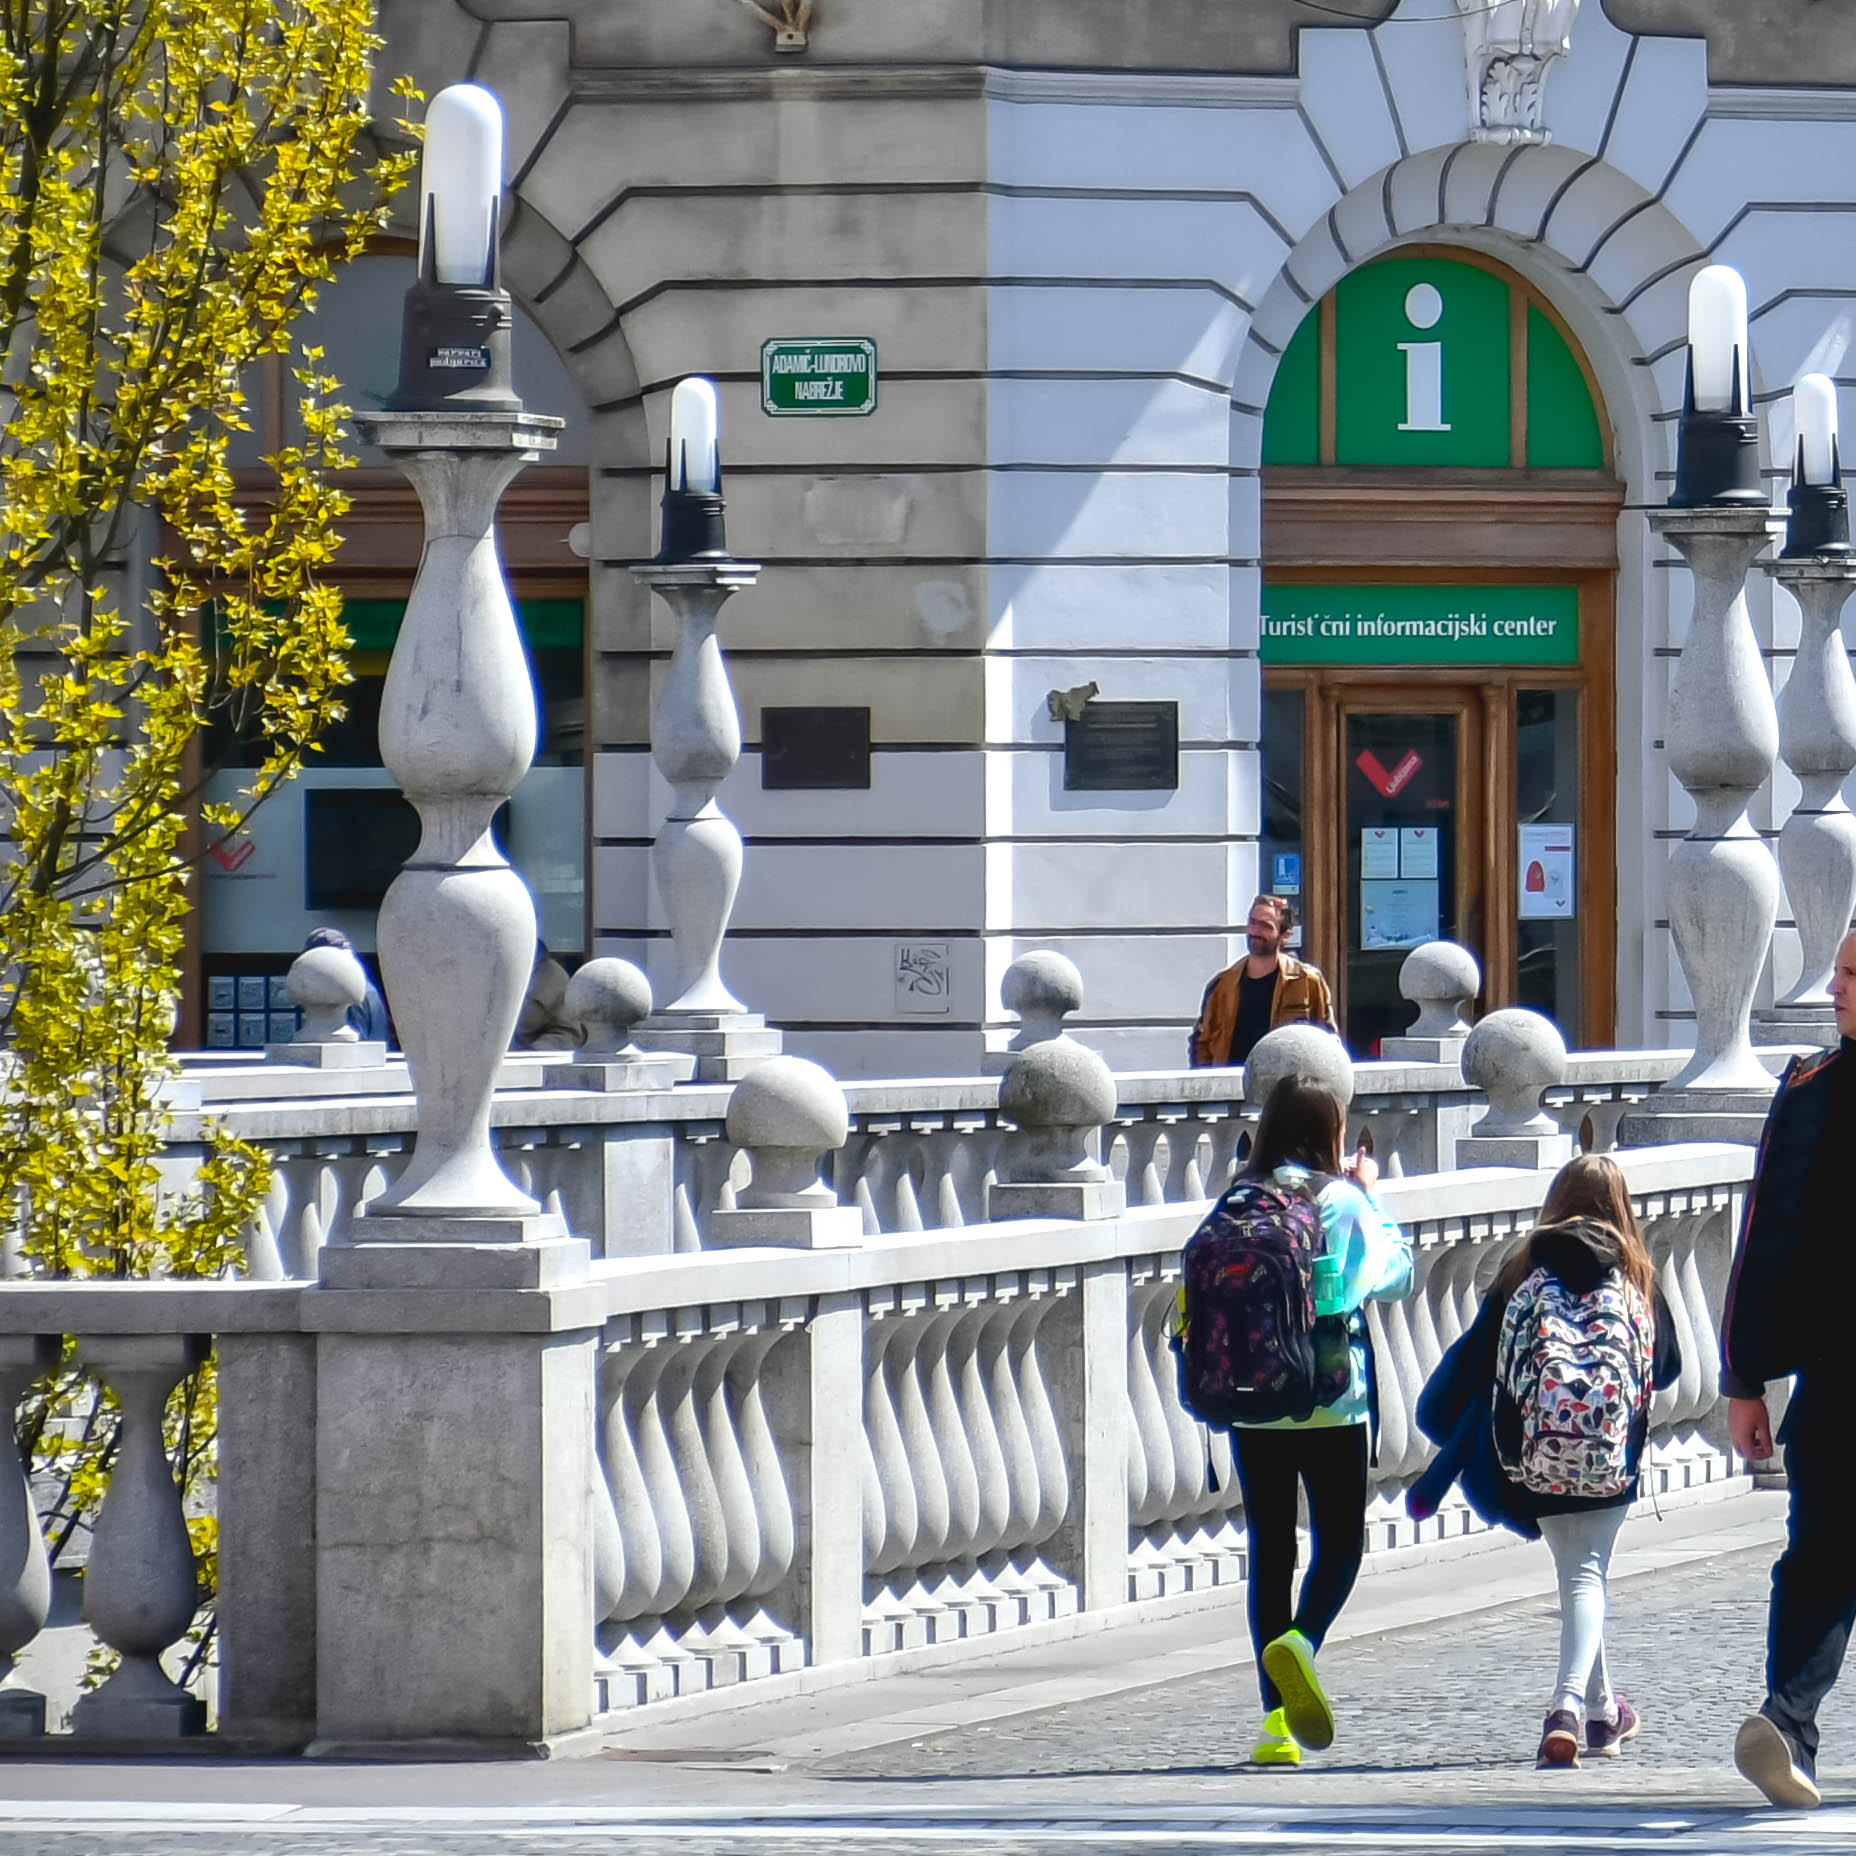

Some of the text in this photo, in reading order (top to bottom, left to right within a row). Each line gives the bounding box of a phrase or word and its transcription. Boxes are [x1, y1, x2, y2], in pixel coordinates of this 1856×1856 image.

[794, 376, 844, 400] NABREŽJE
[1357, 612, 1487, 641] informacijski
[1493, 615, 1557, 637] center
